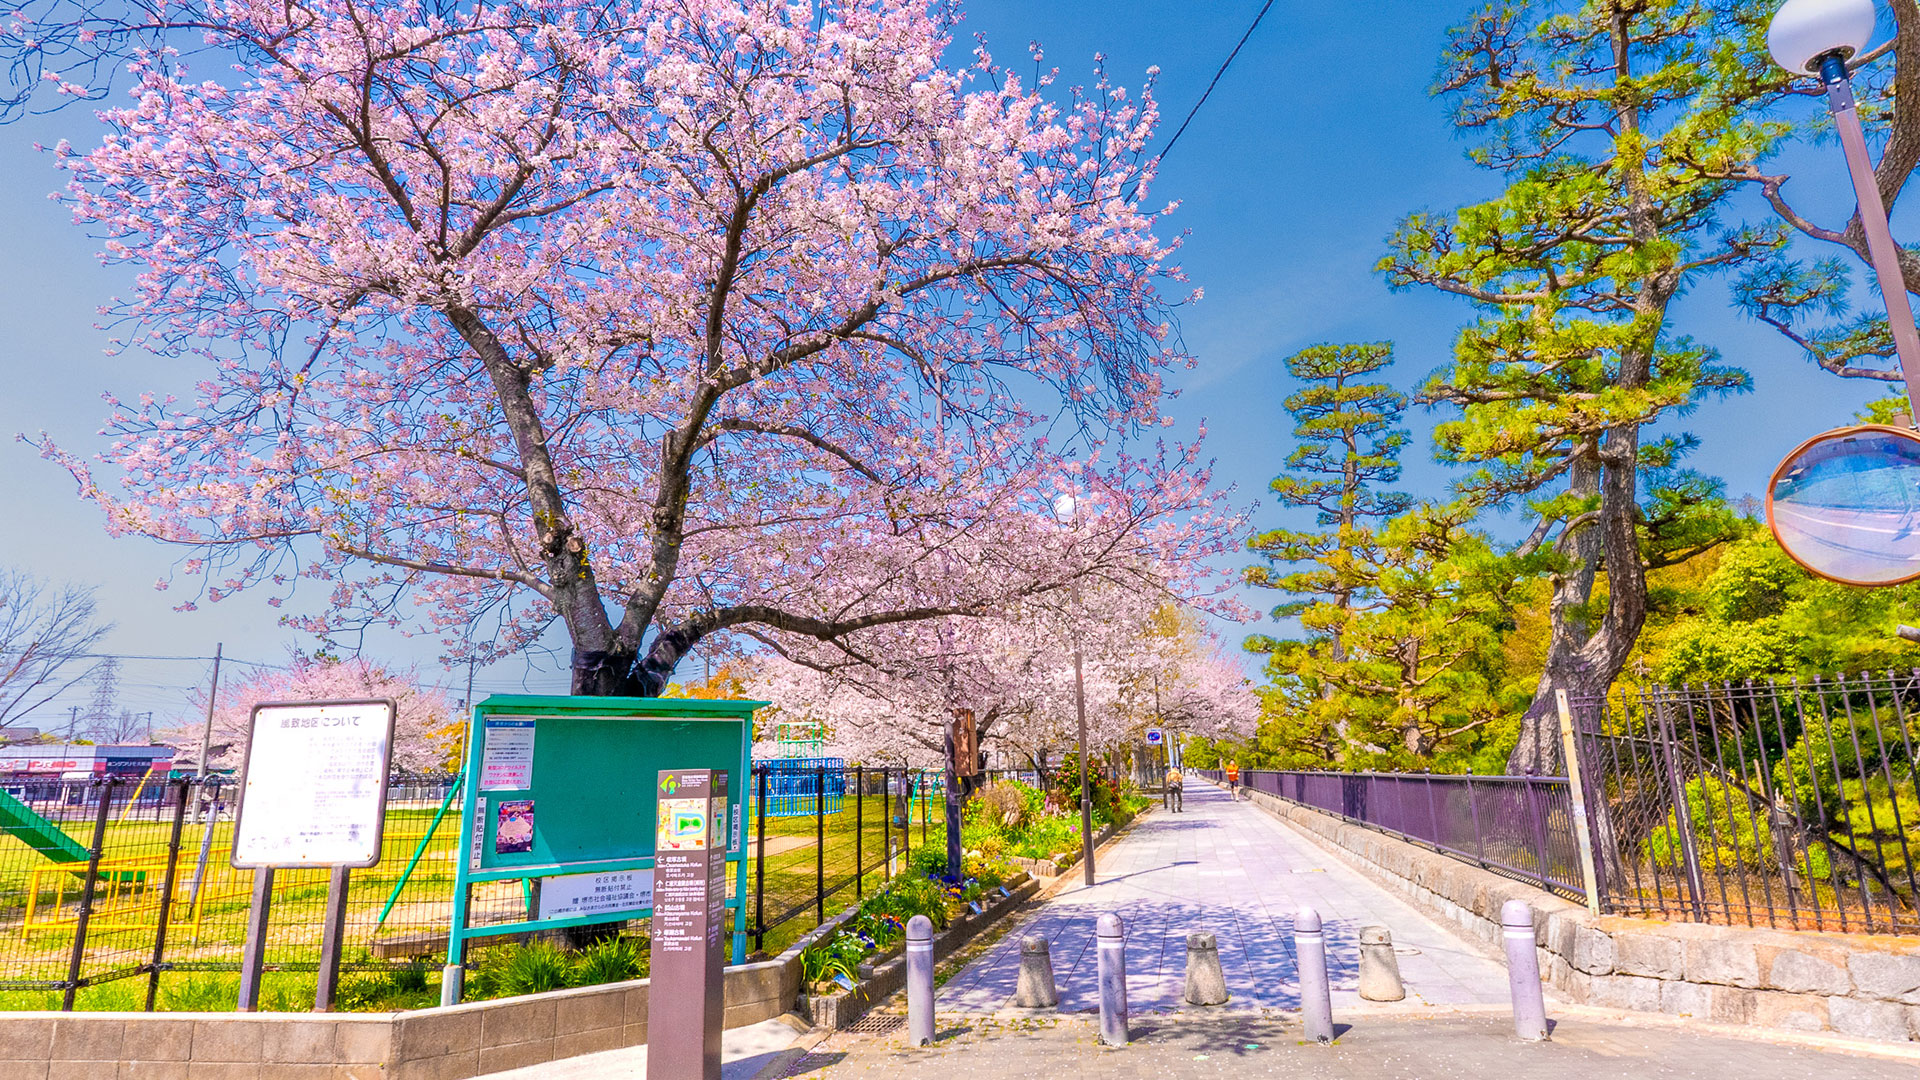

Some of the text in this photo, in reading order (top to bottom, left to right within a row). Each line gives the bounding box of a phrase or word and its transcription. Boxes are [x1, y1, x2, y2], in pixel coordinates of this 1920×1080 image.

[595, 874, 633, 883] 校区掲示板
[594, 884, 632, 893] 無断貼付禁止
